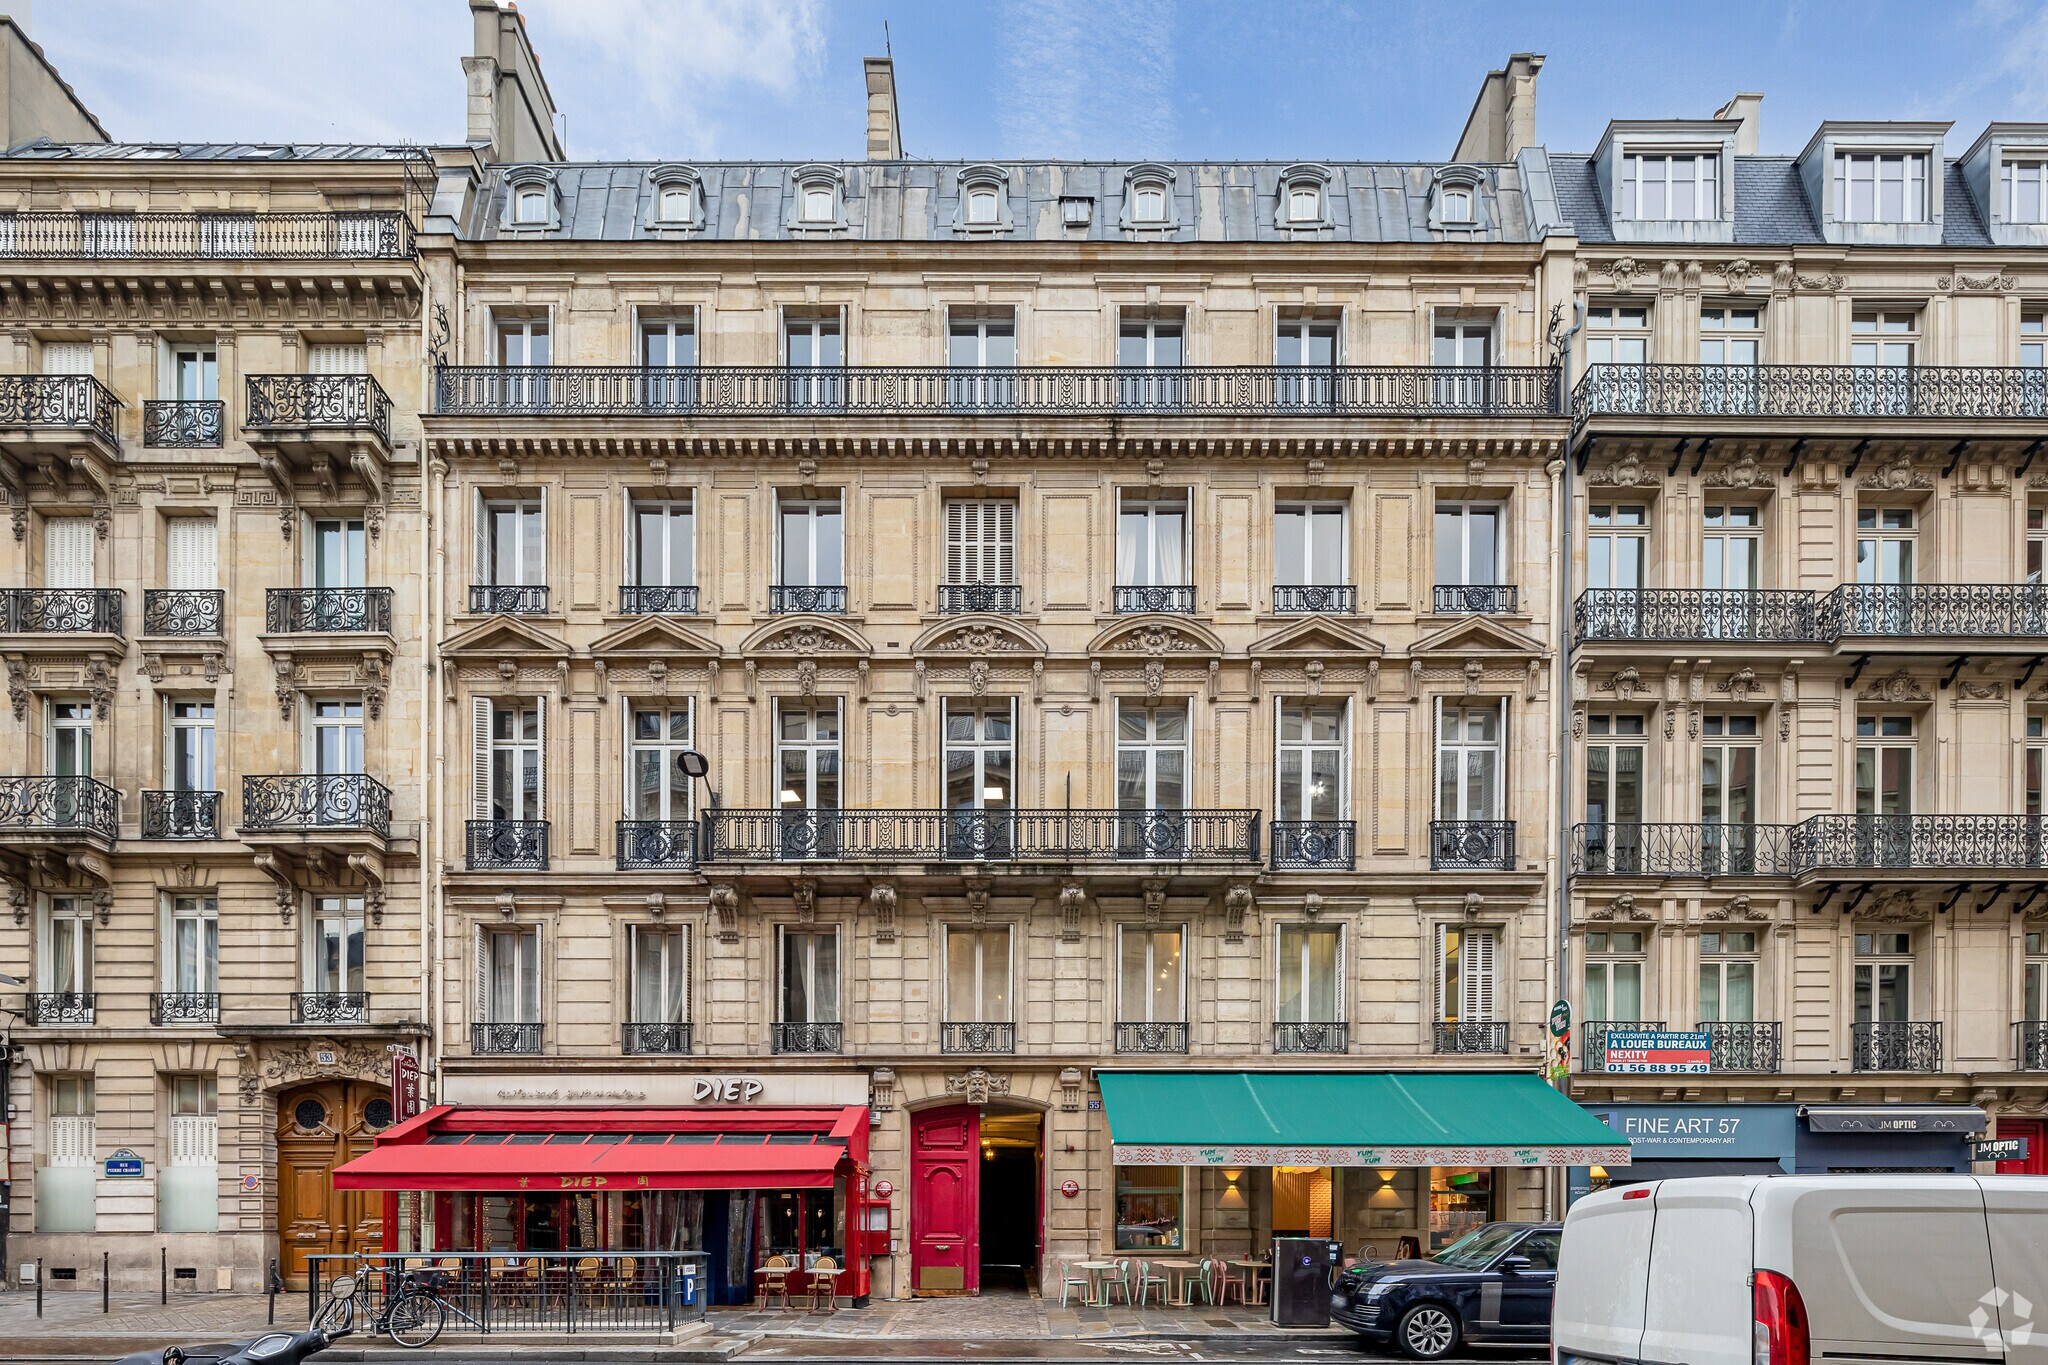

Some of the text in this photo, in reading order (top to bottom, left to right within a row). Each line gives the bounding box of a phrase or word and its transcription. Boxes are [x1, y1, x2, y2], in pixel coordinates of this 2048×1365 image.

[1610, 1040, 1707, 1049] A LOUER BUREAUX
[320, 1053, 332, 1062] 53
[1610, 1050, 1648, 1059] NEXITY
[1608, 1064, 1707, 1073] 01 56 88 95 49
[401, 1069, 419, 1081] DIEP
[692, 1078, 764, 1102] DIEP
[1089, 1100, 1100, 1109] 55
[1625, 1117, 1670, 1134] FINE
[1673, 1117, 1714, 1134] ART
[1718, 1118, 1741, 1134] 57
[1878, 1119, 1917, 1130] JM OPTIC
[1977, 1140, 2019, 1153] JM OPTIC
[560, 1176, 608, 1188] DIEP
[687, 1278, 694, 1301] P
